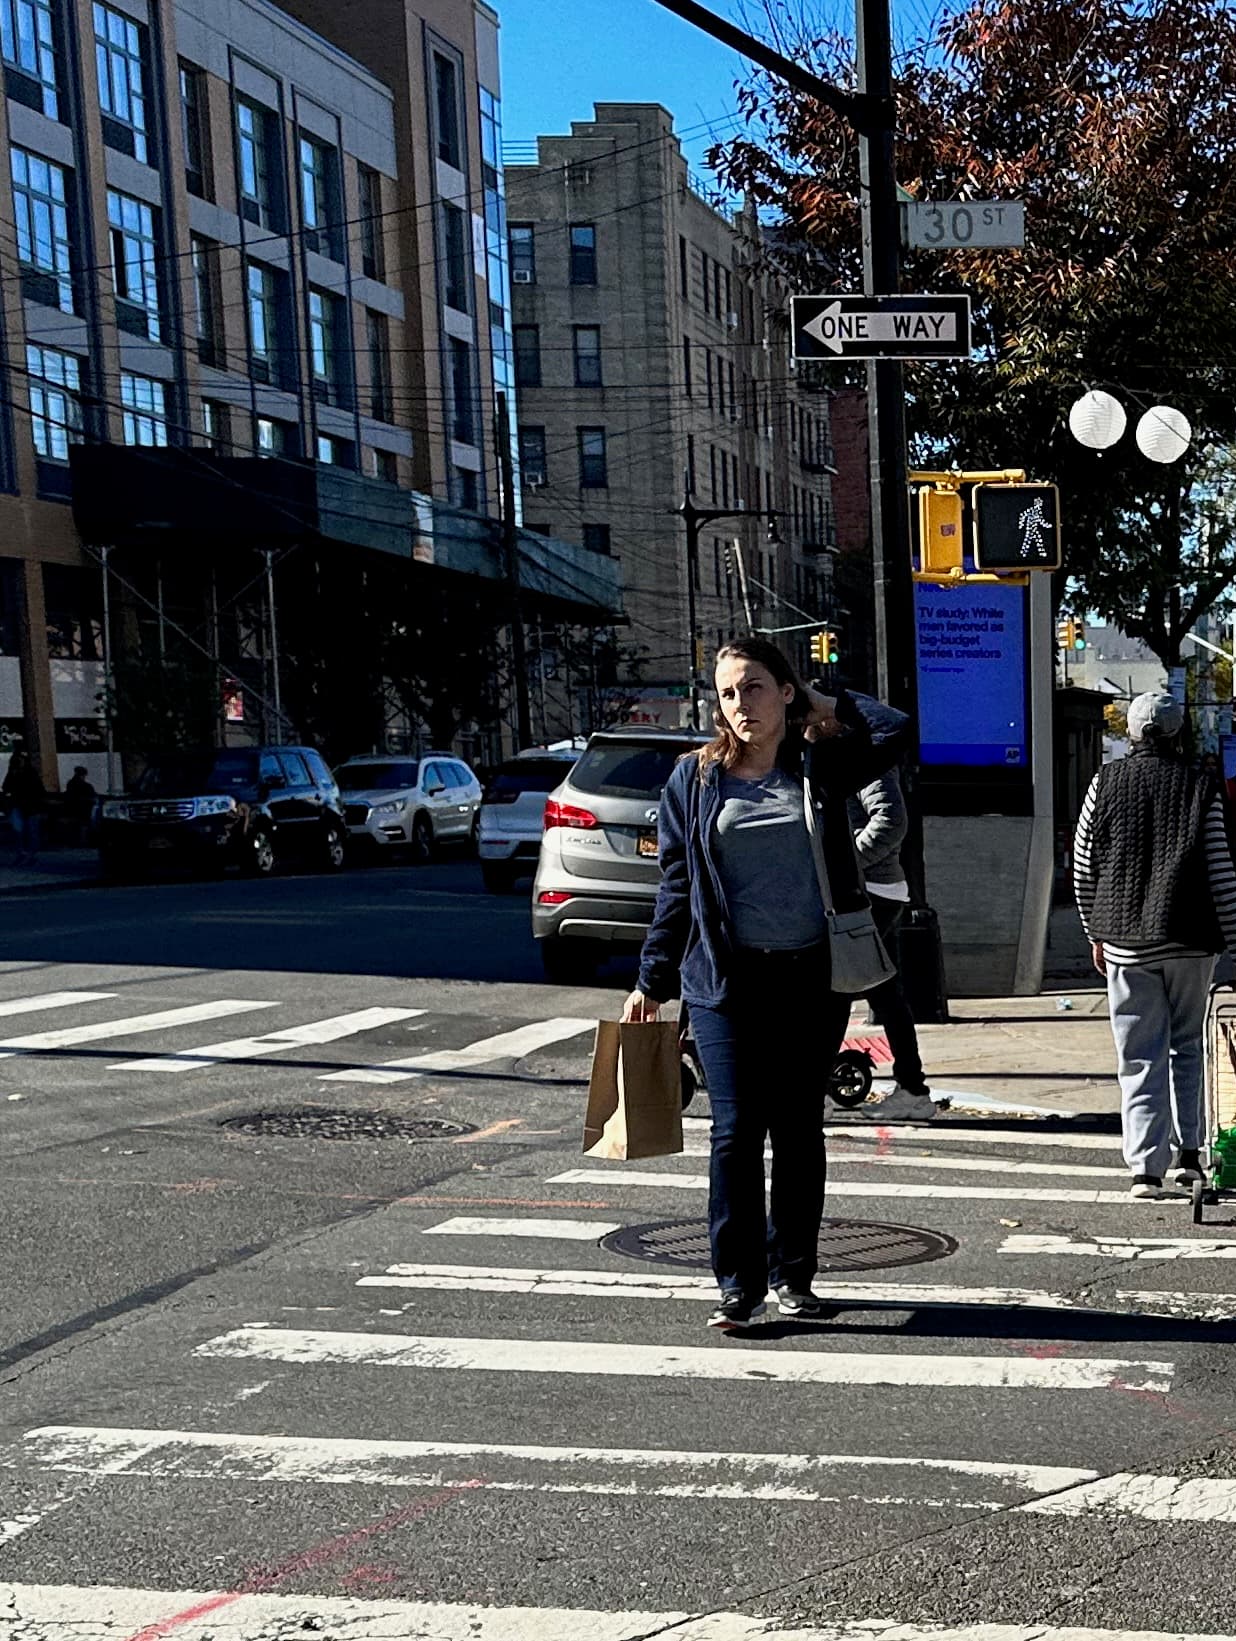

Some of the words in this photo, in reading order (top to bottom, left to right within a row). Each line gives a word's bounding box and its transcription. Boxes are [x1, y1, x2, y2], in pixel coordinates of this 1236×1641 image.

[924, 207, 974, 243] 30
[982, 207, 1005, 226] ST
[821, 315, 869, 339] ONE
[893, 315, 945, 339] WAY
[919, 607, 933, 618] TV
[936, 607, 969, 620] study:
[972, 607, 1004, 619] White
[919, 622, 944, 632] men
[947, 621, 989, 633] favored
[990, 623, 1004, 633] as
[919, 633, 980, 647] big-budget
[919, 647, 953, 659] series
[955, 647, 1002, 659] creators
